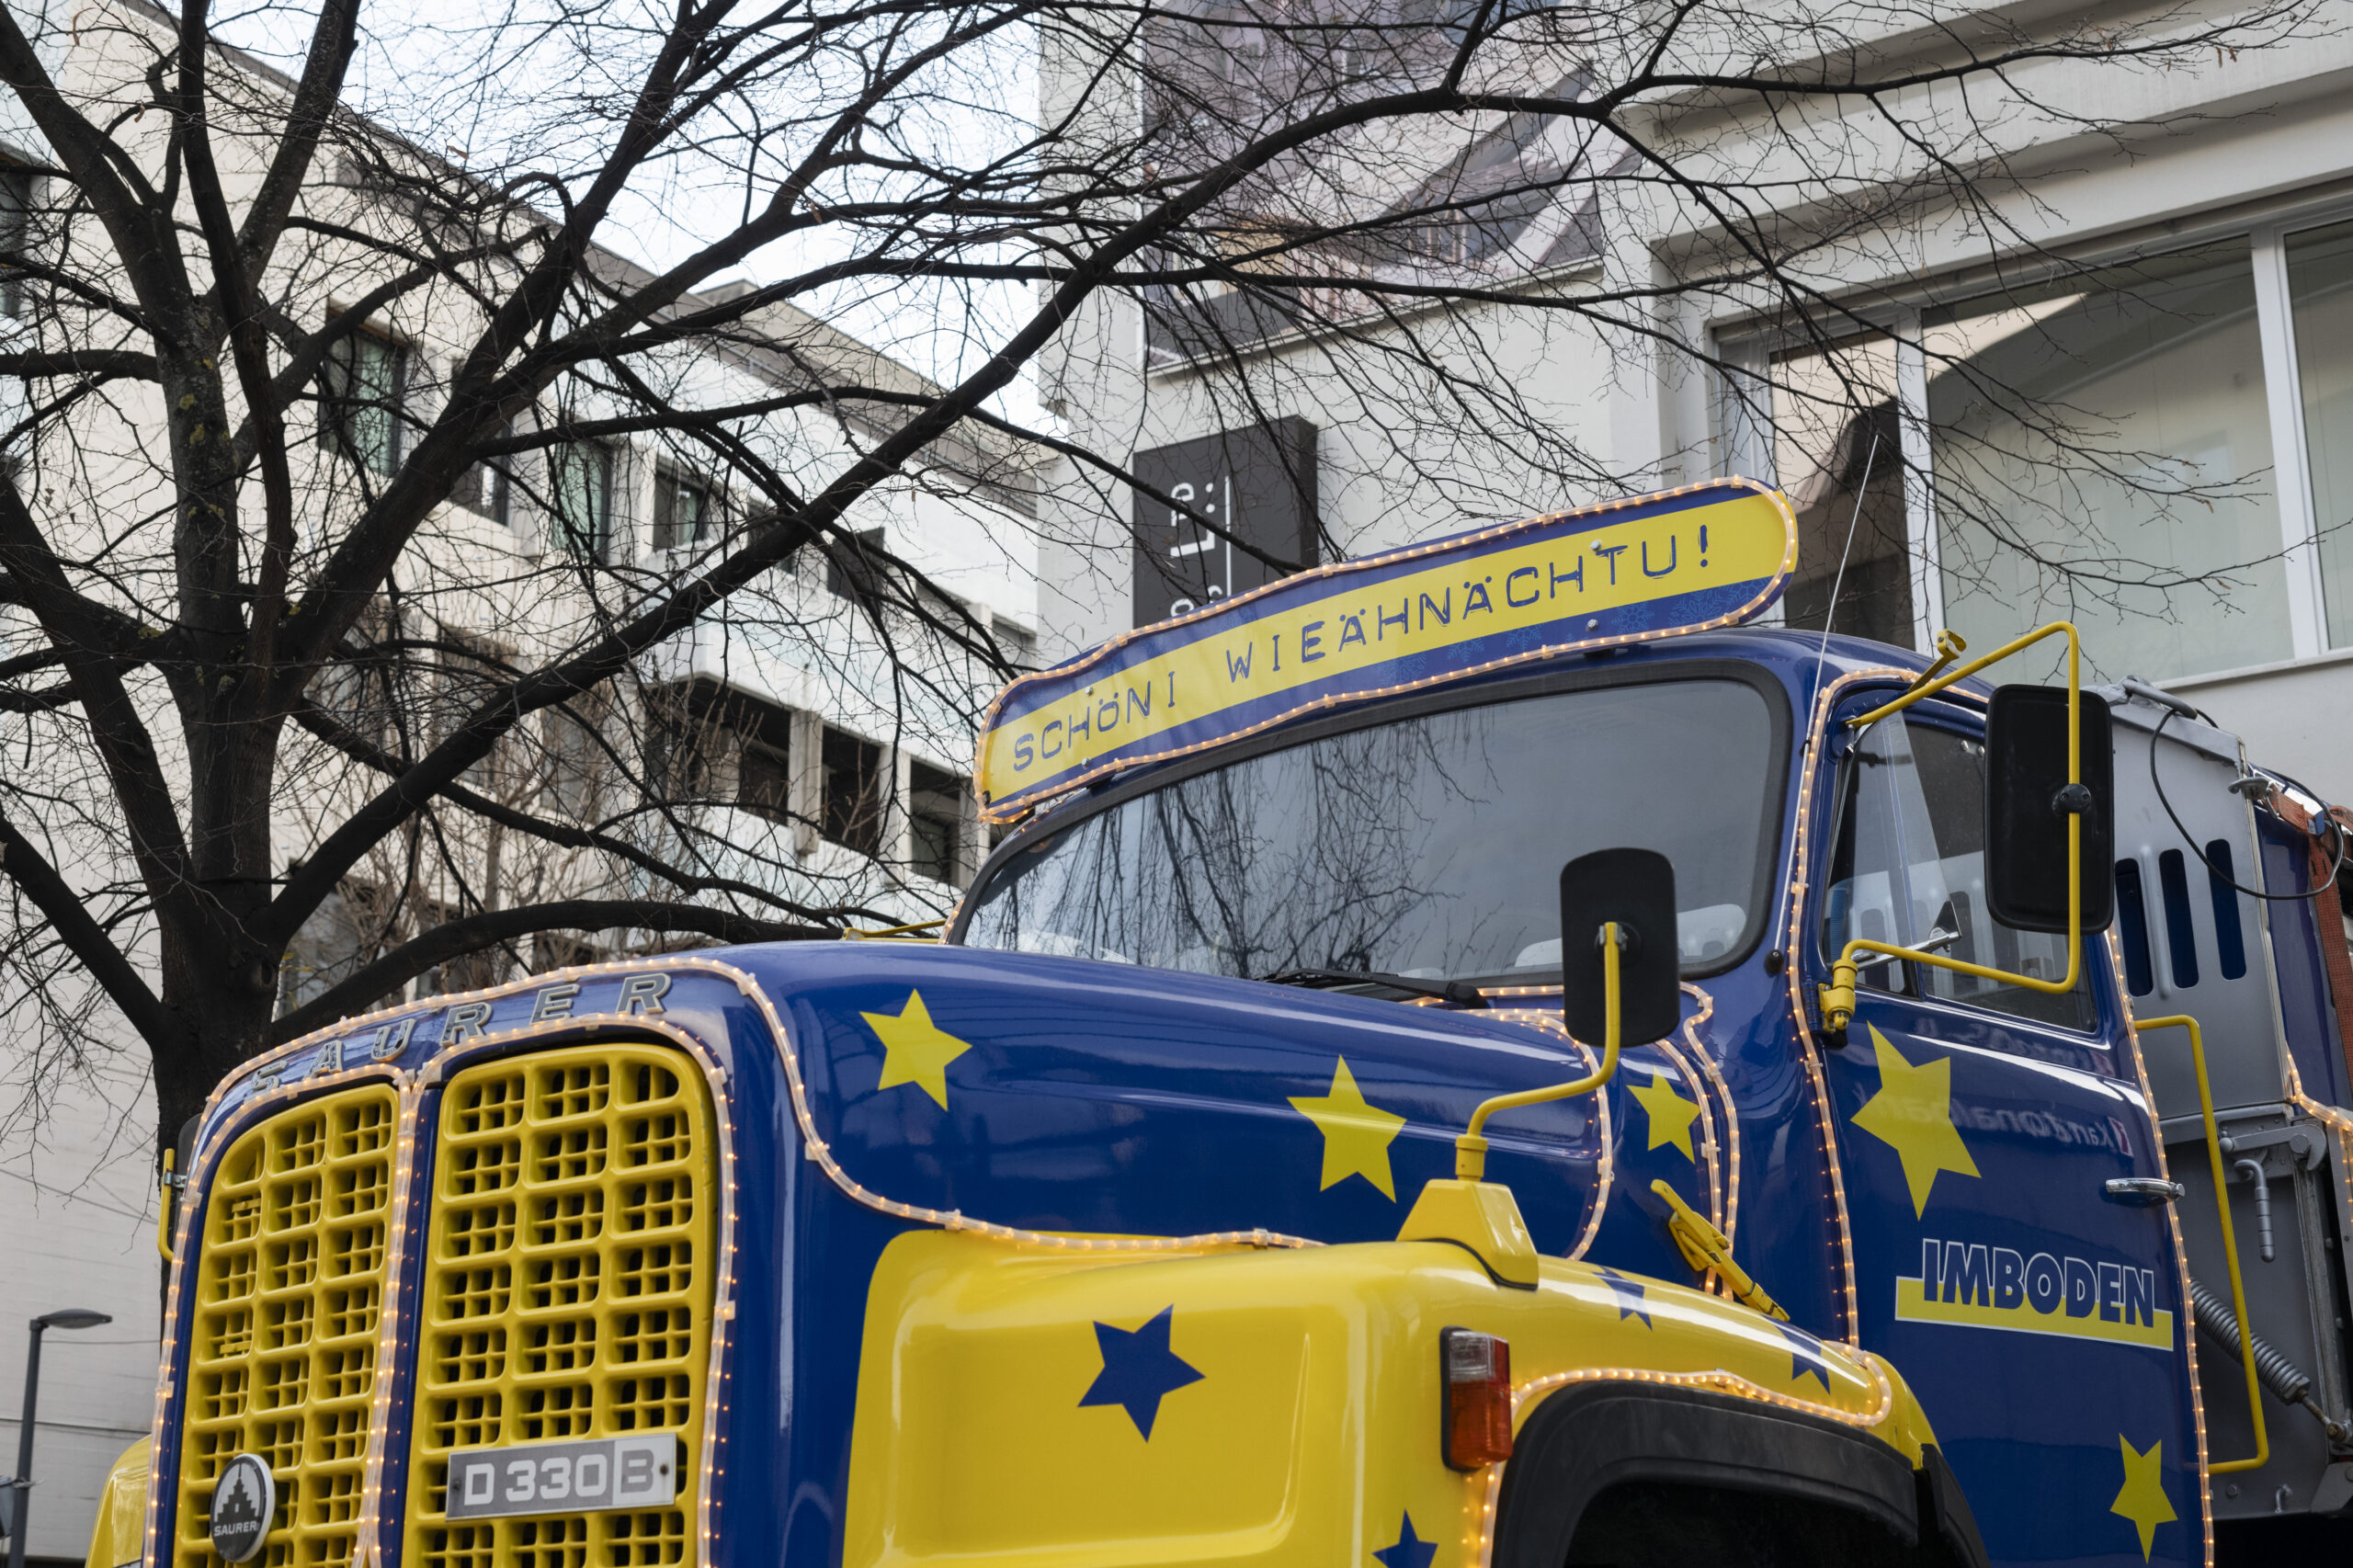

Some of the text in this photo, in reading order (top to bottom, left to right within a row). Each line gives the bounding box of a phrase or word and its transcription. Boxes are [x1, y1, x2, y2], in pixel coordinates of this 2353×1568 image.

[1013, 525, 1708, 772] SCHÖNI WIEÄHNÄCHTU!
[244, 972, 672, 1102] SAURER
[1922, 1238, 2154, 1329] IMBODEN
[214, 1520, 257, 1537] SAURER
